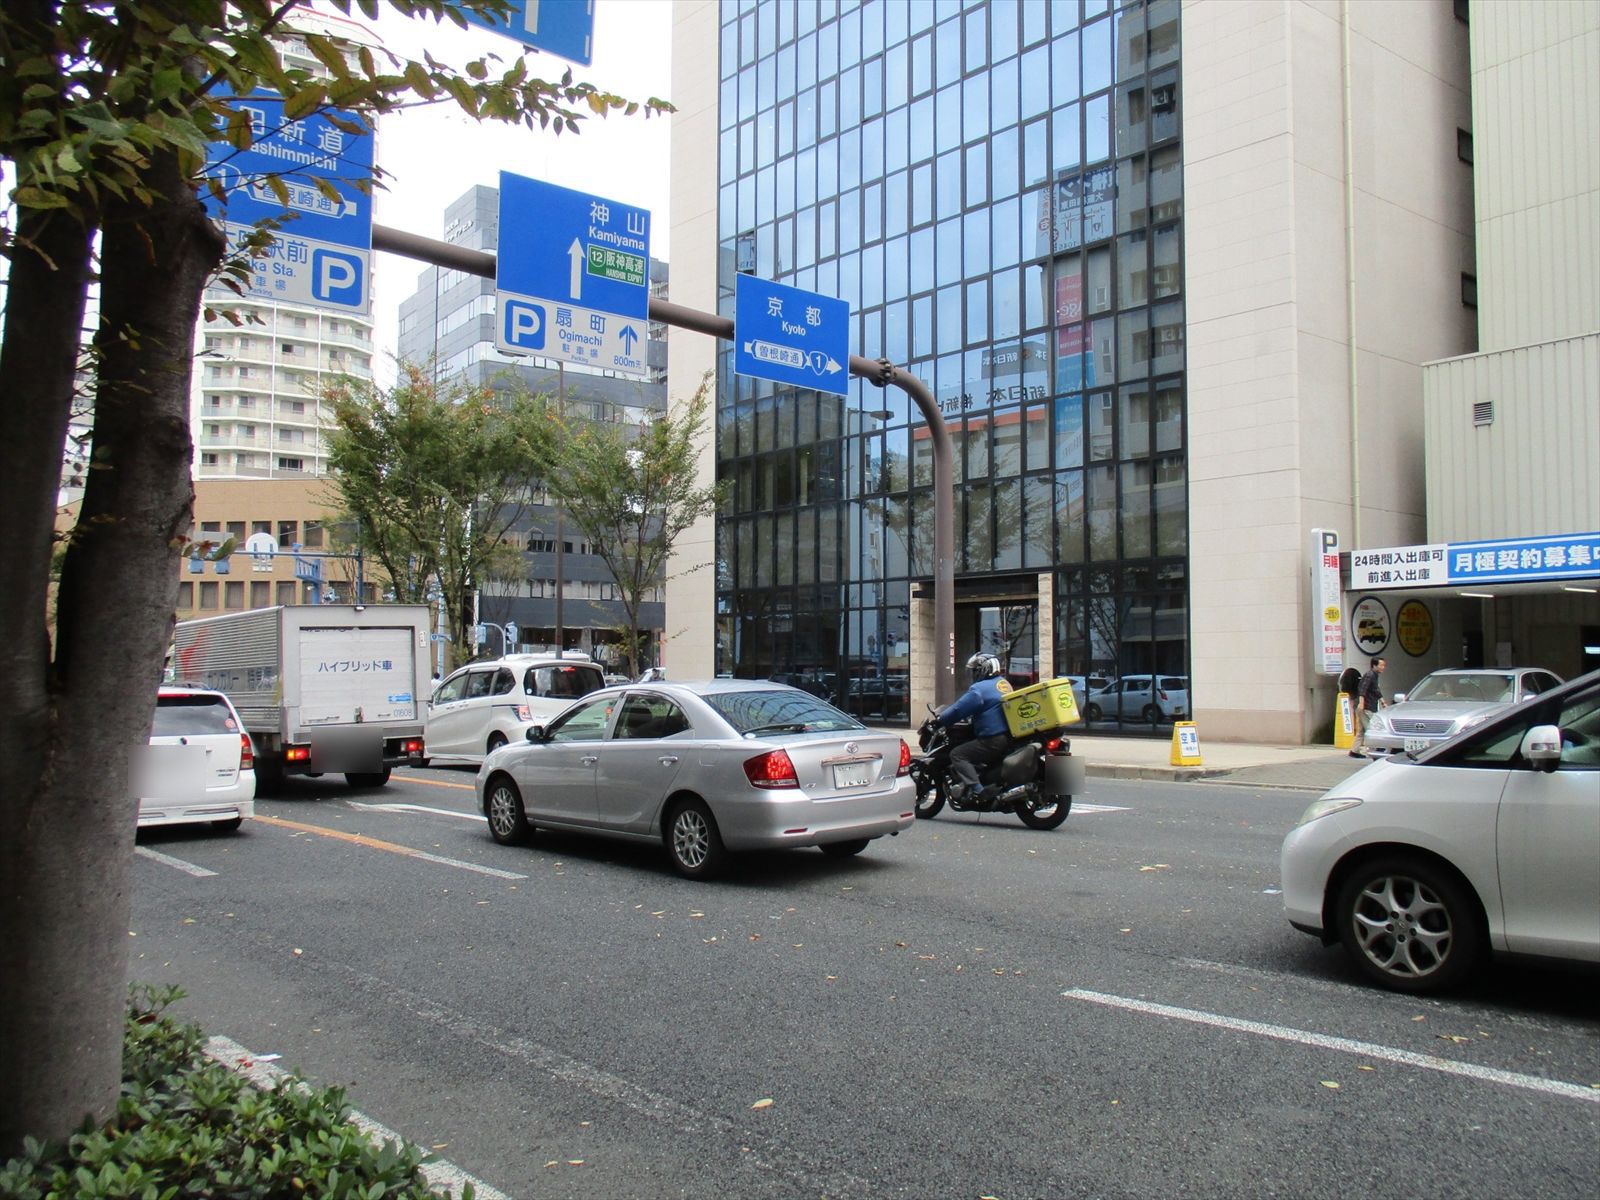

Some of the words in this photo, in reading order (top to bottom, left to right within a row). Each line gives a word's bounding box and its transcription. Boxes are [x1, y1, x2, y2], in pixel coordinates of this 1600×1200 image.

[589, 201, 645, 236] 神山
[589, 226, 645, 251] Kamiyama
[591, 250, 603, 264] 12
[606, 251, 645, 274] 阪神高速
[272, 262, 297, 279] Sta.
[606, 268, 626, 281] HANSHIN
[768, 296, 821, 327] 京都
[556, 307, 607, 335] 扇町
[781, 320, 807, 336] Kyoto
[558, 329, 603, 347] Ogimachi
[1321, 532, 1338, 554] P
[1354, 548, 1444, 567] 24時間入出庫可
[1367, 568, 1430, 584] 前進入出庫
[318, 660, 393, 673] ハイブリッド車
